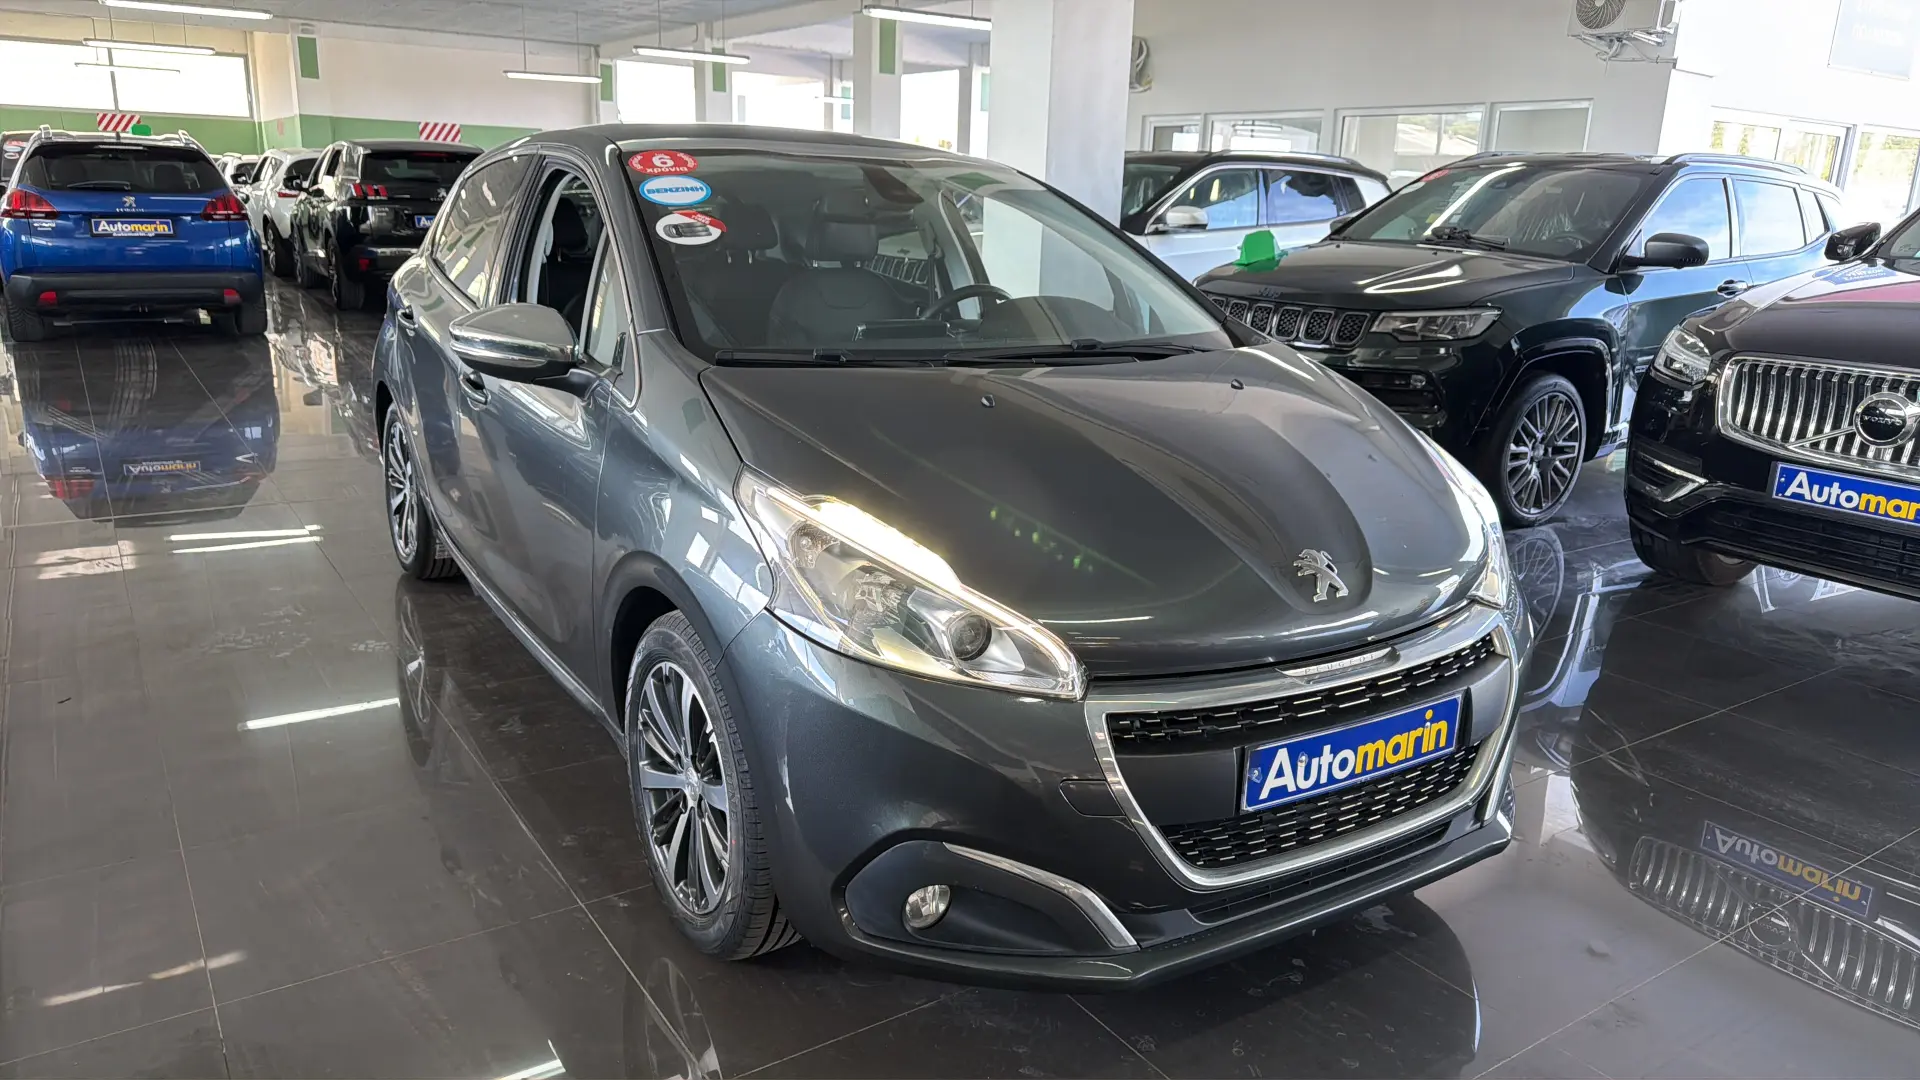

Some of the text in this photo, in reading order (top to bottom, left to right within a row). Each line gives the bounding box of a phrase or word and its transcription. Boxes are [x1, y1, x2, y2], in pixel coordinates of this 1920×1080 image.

[652, 154, 674, 168] 6
[98, 220, 168, 232] Automarin
[1258, 709, 1449, 801] Automarin
